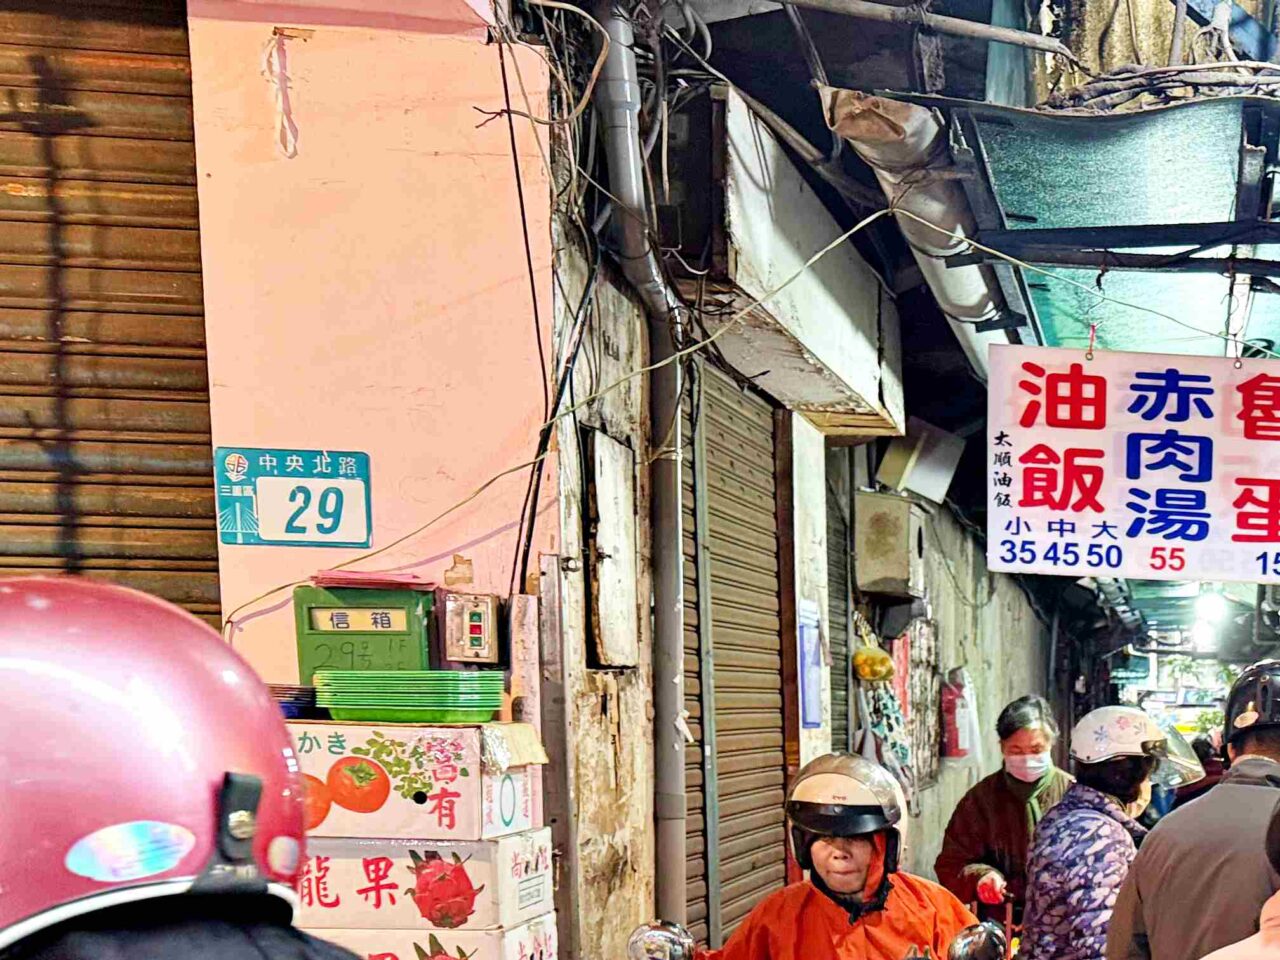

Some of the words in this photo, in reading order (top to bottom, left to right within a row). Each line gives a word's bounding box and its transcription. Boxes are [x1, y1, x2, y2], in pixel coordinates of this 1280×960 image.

[1018, 362, 1107, 514] 油飯
[259, 453, 358, 476] 中央北路
[993, 431, 1014, 508] 太順油飯
[1126, 368, 1215, 542] 赤肉湯
[284, 485, 344, 535] 29
[1005, 516, 1031, 535] 小
[1048, 519, 1076, 539] 中
[1092, 521, 1118, 540] 大
[1000, 540, 1036, 564] 35
[1043, 542, 1079, 566] 45
[1086, 544, 1122, 568] 50
[1150, 547, 1185, 571] 55
[329, 611, 392, 630] 信箱
[298, 731, 347, 756] かき
